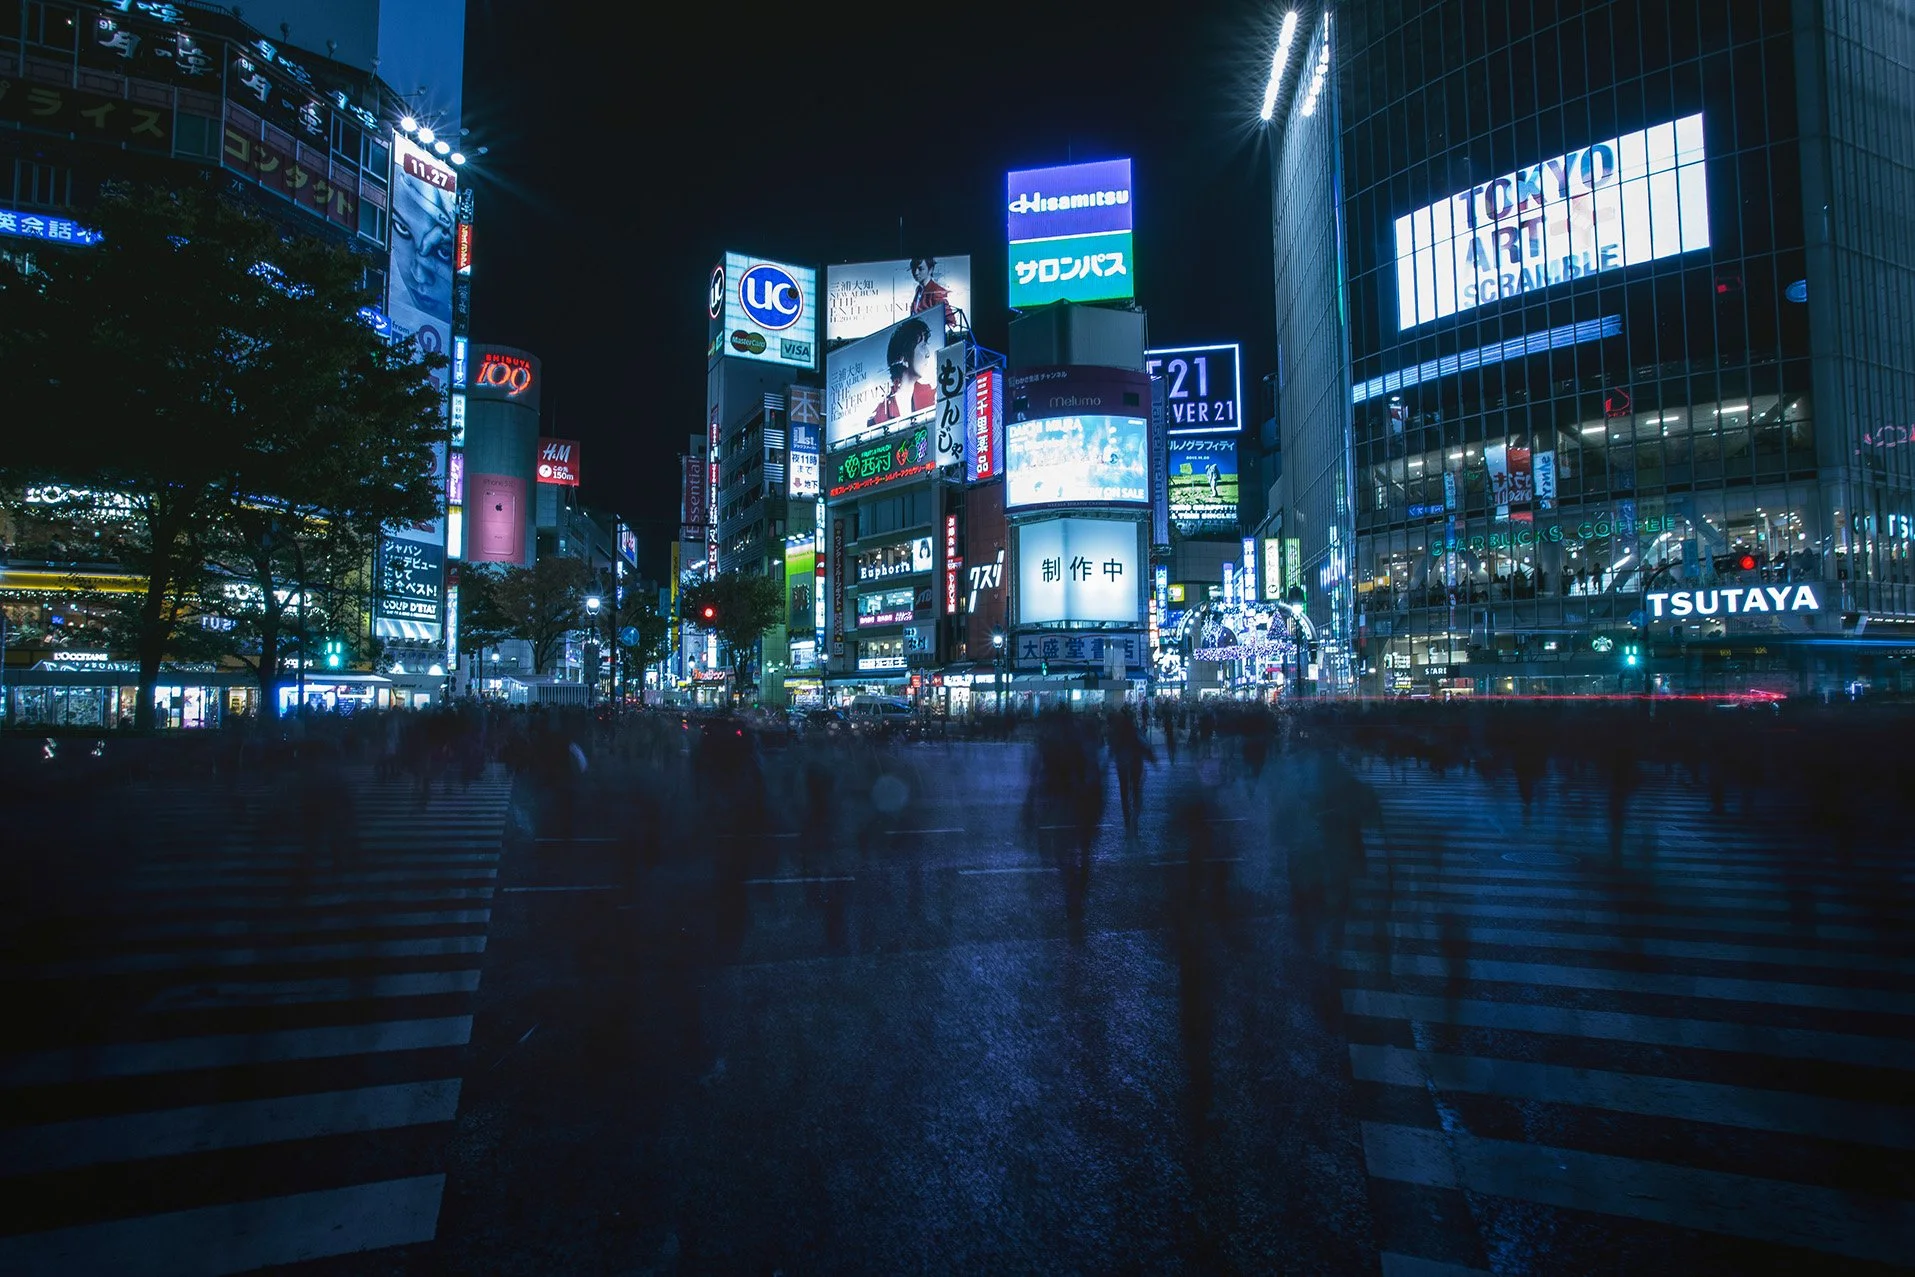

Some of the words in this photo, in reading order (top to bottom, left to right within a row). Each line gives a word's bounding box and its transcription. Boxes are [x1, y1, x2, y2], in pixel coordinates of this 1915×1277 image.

[98, 19, 117, 30] 9F
[241, 59, 255, 72] 9F
[224, 129, 354, 215] コンタクト
[411, 158, 448, 187] 11.27
[1459, 144, 1614, 229] TOKYO
[1009, 189, 1129, 214] Hisamitsu
[1464, 216, 1543, 273] ART
[1014, 252, 1127, 285] サロンパス
[1464, 243, 1619, 307] SCRAMBLE
[747, 277, 798, 315] UC
[392, 321, 410, 334] from
[731, 336, 766, 348] MasterCard
[784, 344, 810, 357] VISA
[485, 353, 531, 369] SHIBUYA
[475, 361, 532, 396] 109
[938, 358, 963, 459] もんじゃ
[1214, 400, 1234, 421] 21
[976, 376, 989, 473] 三千里薬品
[542, 443, 571, 463] H&M
[861, 452, 891, 477] 西村
[553, 471, 574, 481] 150m
[686, 459, 700, 535] Essential
[1121, 488, 1145, 499] SALE
[385, 541, 422, 557] ジャパン
[860, 561, 911, 580] Euphoria
[968, 550, 1005, 613] クスリ
[1041, 556, 1123, 583] 制作中
[916, 589, 932, 605] JTB
[1647, 585, 1819, 617] TSUTAYA
